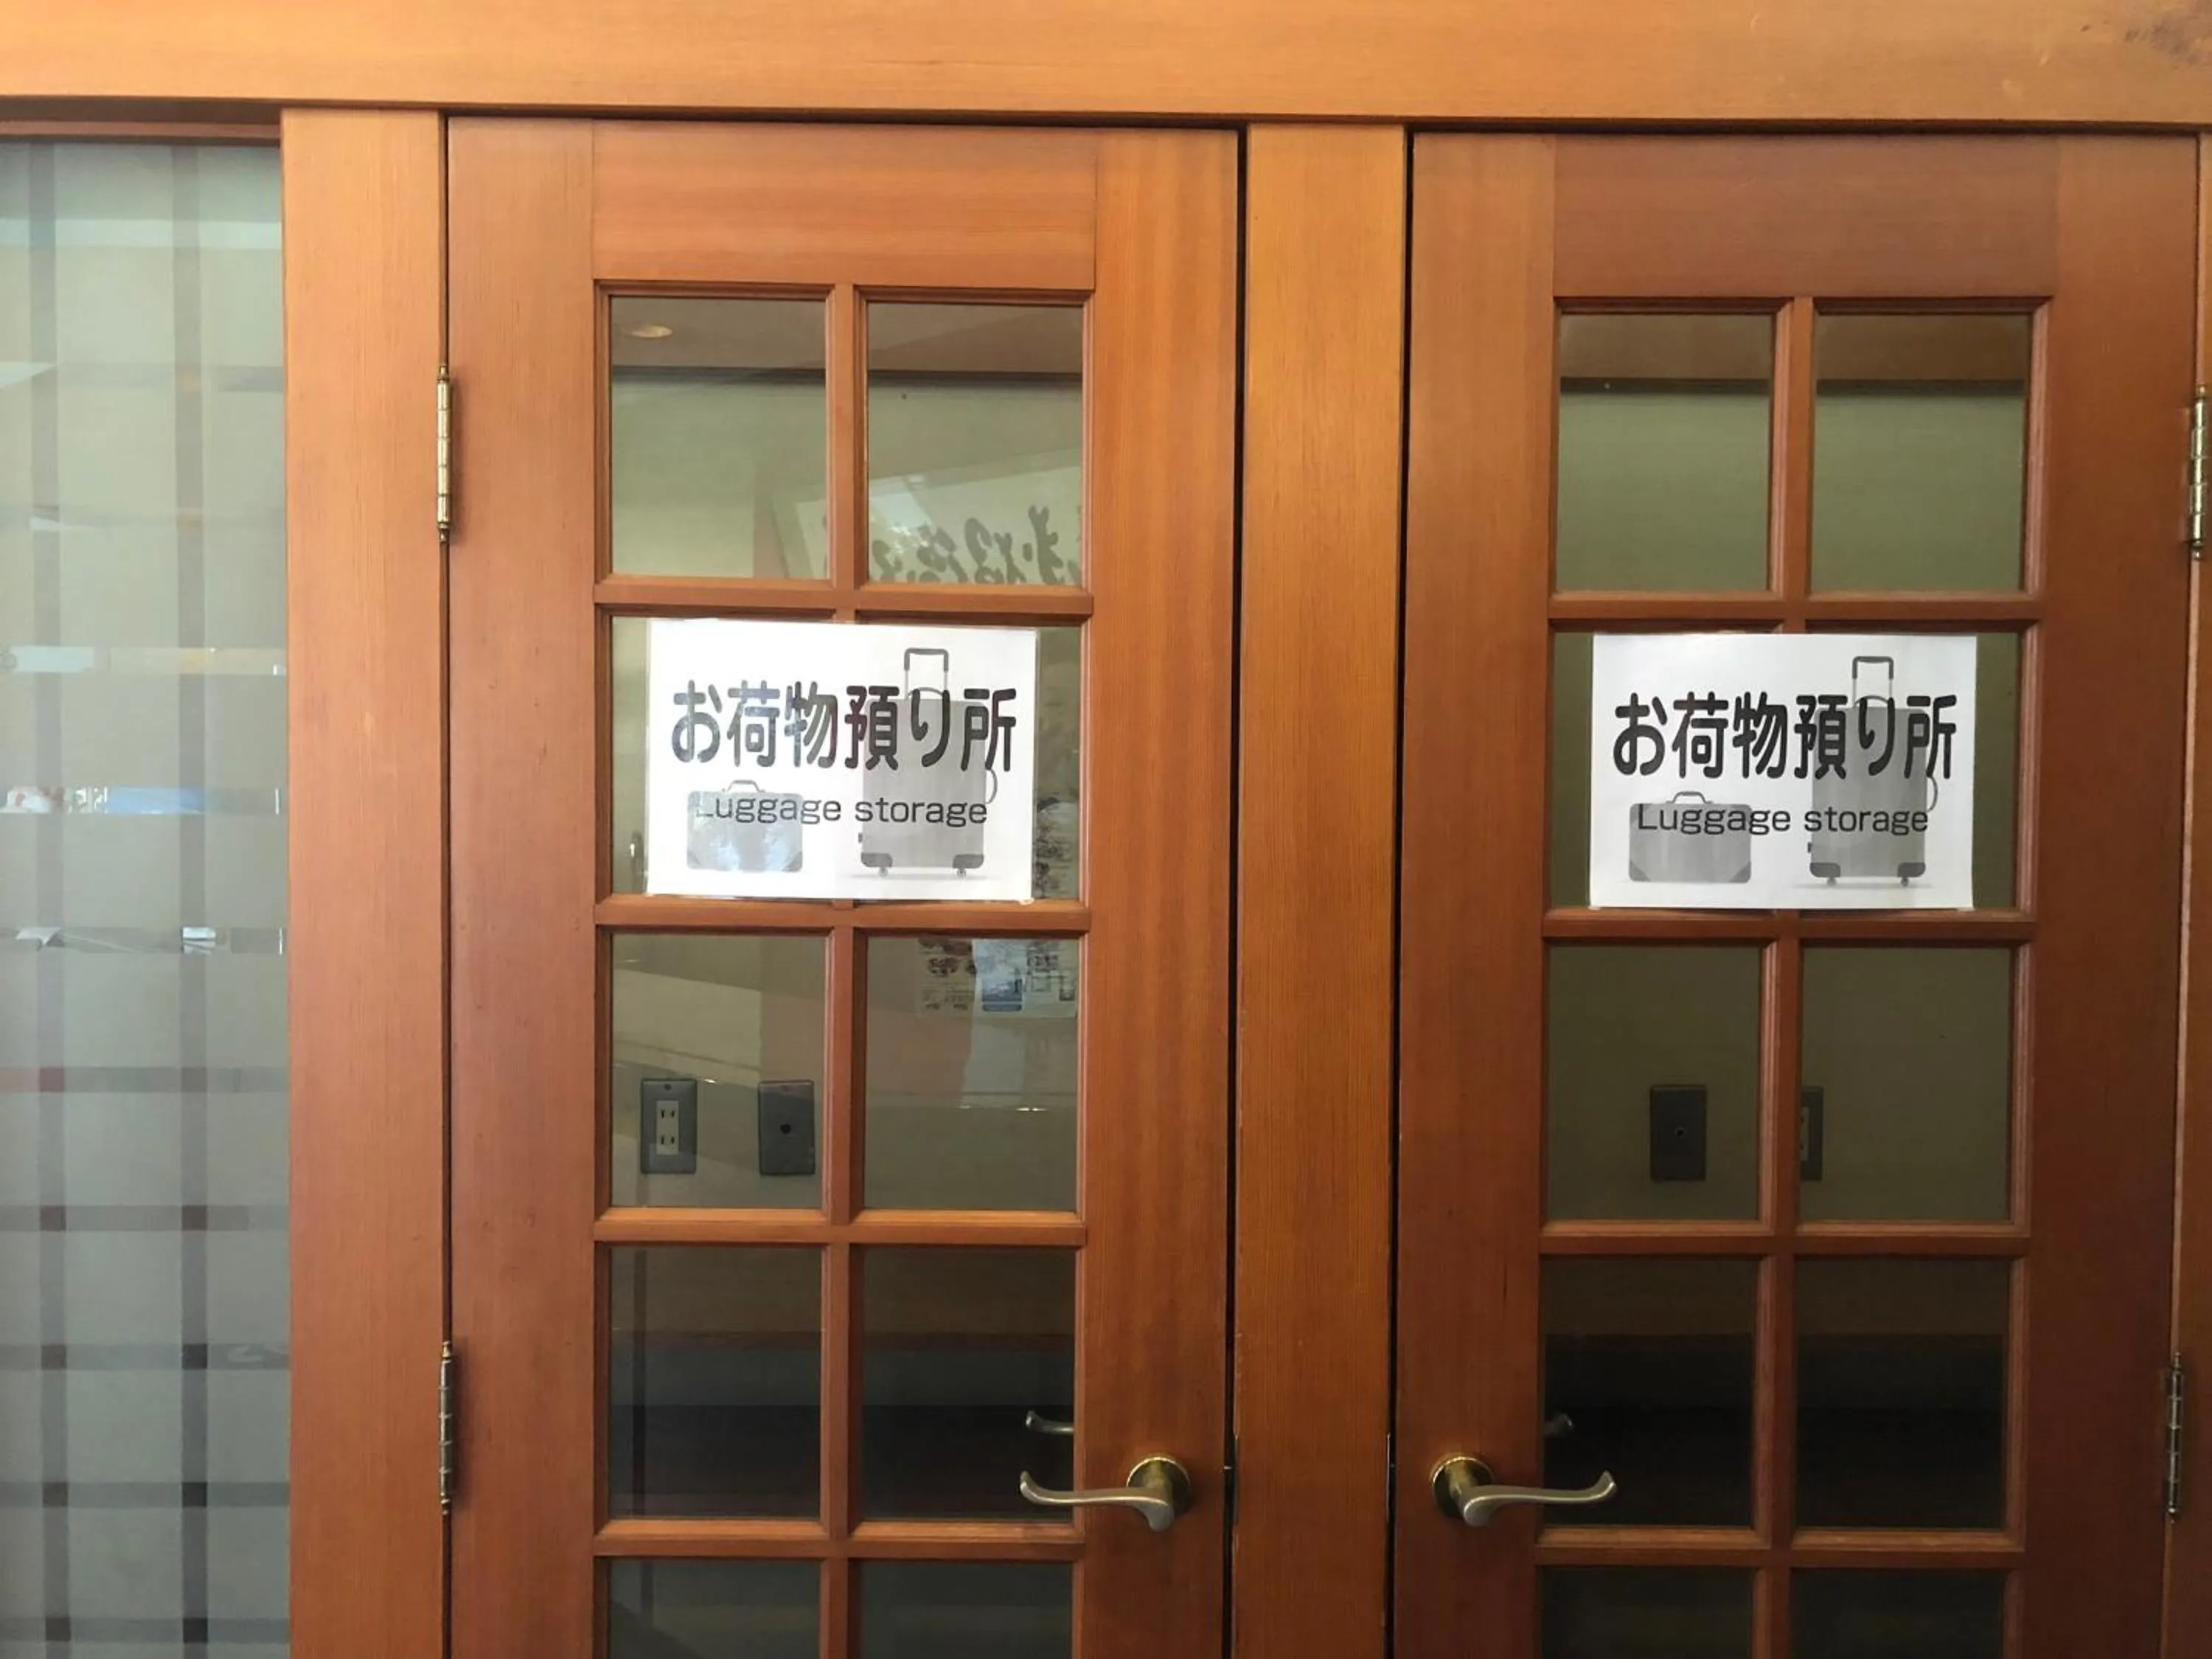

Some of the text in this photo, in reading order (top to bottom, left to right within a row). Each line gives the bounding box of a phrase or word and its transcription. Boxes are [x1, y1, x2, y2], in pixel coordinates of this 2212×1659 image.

[672, 680, 1016, 771] お荷物預り所
[1613, 691, 1957, 779] お荷物預り所
[695, 797, 987, 827] Luggage storage
[1638, 804, 1928, 835] Luggage storage
